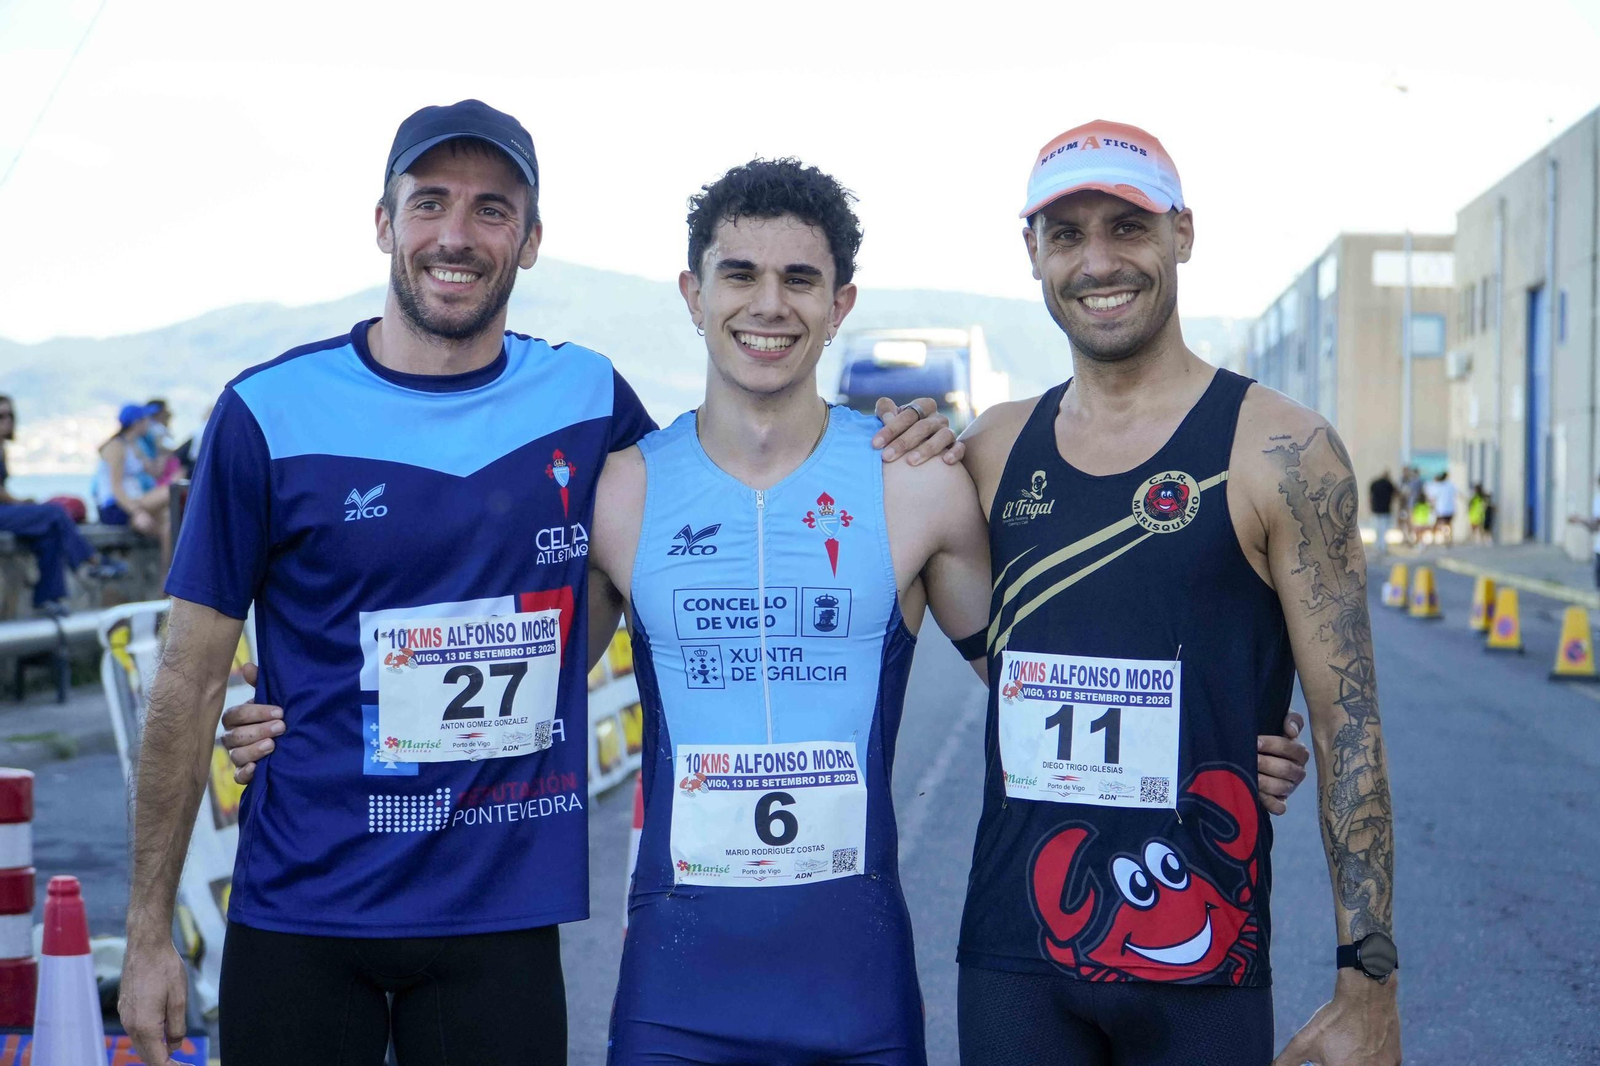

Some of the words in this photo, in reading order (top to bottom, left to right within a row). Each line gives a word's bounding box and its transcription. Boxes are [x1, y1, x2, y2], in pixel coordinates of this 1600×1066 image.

[1041, 136, 1148, 166] NEUMATICOS
[1149, 473, 1188, 485] C.A.R.
[1002, 501, 1015, 519] El
[1015, 498, 1056, 520] Trigal
[1133, 495, 1199, 532] MARISQUEIRO
[536, 543, 589, 565] ATLETIMO
[683, 596, 788, 612] CONCELLO
[696, 616, 722, 631] DE
[726, 614, 776, 630] VIGO
[388, 626, 443, 649] 10KMS
[447, 621, 517, 647] ALFONSO
[522, 618, 556, 642] MORO
[415, 652, 443, 664] VIGO,
[445, 652, 457, 662] 13
[459, 651, 472, 661] DE
[474, 647, 525, 660] SETEMBRO
[526, 646, 537, 656] DE
[538, 644, 556, 655] 2026
[729, 647, 803, 664] XUNTA
[731, 667, 757, 682] DE
[762, 665, 847, 682] GALICIA
[1008, 660, 1046, 683] 10KMS
[1050, 663, 1121, 689] ALFONSO
[1125, 668, 1174, 691] MORO
[442, 661, 529, 721] 27
[1023, 687, 1045, 699] VIGO,
[1047, 690, 1058, 699] 13
[1060, 691, 1073, 700] DE
[1074, 692, 1127, 703] SETEMBRO
[1130, 695, 1143, 704] DE
[1145, 696, 1171, 705] 2026
[440, 721, 465, 731] ANTON
[466, 719, 493, 729] GOMEZ
[494, 716, 529, 728] GONZALEZ
[1045, 704, 1122, 764] 11
[452, 740, 469, 748] Porto
[469, 740, 477, 748] de
[477, 740, 491, 749] Vigo
[686, 753, 730, 774] 10KMS
[734, 750, 808, 774] ALFONSO
[812, 749, 855, 770] MORO
[1042, 761, 1064, 770] DIEGO
[1066, 763, 1088, 772] TRIGO
[1089, 765, 1124, 775] IGLESIAS
[459, 771, 576, 803] EUTAIÓN
[707, 778, 730, 789] VIGO,
[732, 779, 744, 788] 13
[746, 779, 759, 788] DE
[762, 776, 816, 788] SETEMBRO
[818, 775, 832, 784] DE
[833, 773, 857, 783] 2026
[1047, 782, 1062, 790] Porto
[1072, 784, 1086, 792] Vigo
[1098, 793, 1117, 801] ADN
[452, 792, 583, 827] PONTEVEDRA
[754, 791, 799, 846] 6
[725, 848, 750, 856] MARIO
[796, 844, 826, 854] COSTAS
[759, 867, 767, 875] de
[768, 867, 781, 876] Vigo
